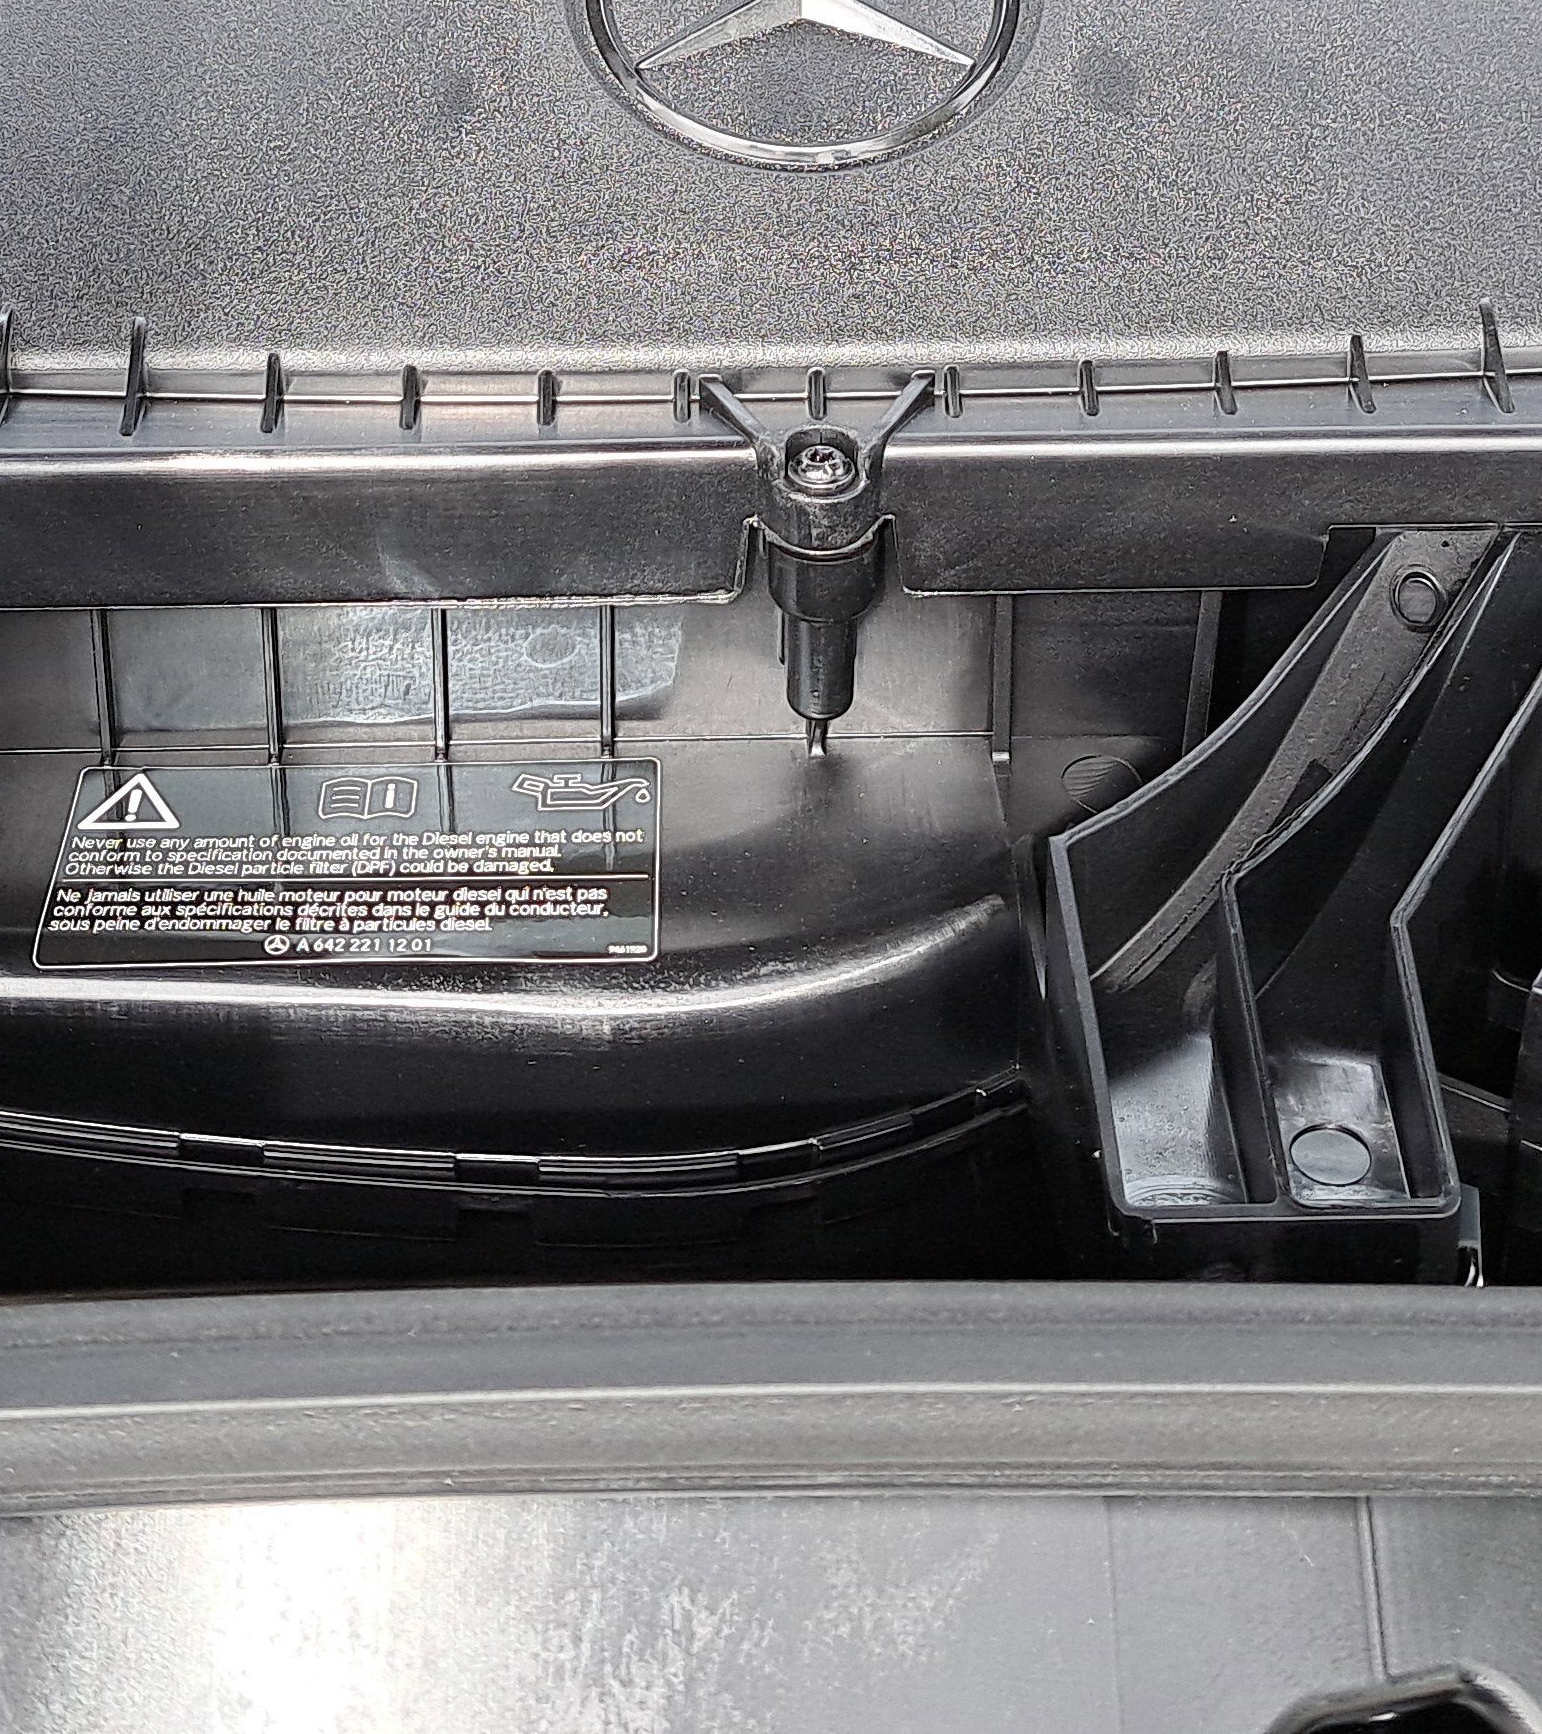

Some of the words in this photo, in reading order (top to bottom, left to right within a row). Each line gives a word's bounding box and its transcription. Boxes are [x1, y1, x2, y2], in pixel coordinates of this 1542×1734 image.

[72, 836, 122, 849] Never
[126, 837, 156, 849] use
[160, 837, 190, 851] any
[193, 835, 255, 849] amount
[260, 834, 279, 848] of
[282, 835, 336, 850] engine
[340, 832, 359, 846] oil
[363, 831, 388, 846] for
[393, 831, 419, 846] the
[422, 830, 472, 846] Diesel
[476, 831, 529, 847] engine
[534, 830, 566, 844] that
[571, 829, 612, 843] does
[615, 829, 644, 843] not
[68, 849, 143, 863] conform
[145, 849, 162, 862] to
[167, 848, 273, 865] specification
[276, 847, 380, 862] documented
[384, 846, 398, 859] in
[403, 846, 428, 859] the
[433, 845, 497, 859] owner's
[501, 844, 562, 858] manual.
[65, 862, 152, 877] Otherwise
[158, 862, 184, 876] the
[188, 862, 238, 876] Diesel
[241, 861, 304, 878] particle
[309, 860, 349, 875] filter
[351, 859, 396, 877] (DPF)
[400, 859, 444, 874] could
[447, 859, 469, 874] be
[57, 888, 80, 903] Ne
[84, 887, 141, 905] jamais
[145, 888, 200, 903] utiliser
[203, 889, 233, 902] une
[238, 887, 276, 902] huile
[278, 888, 341, 903] moteur
[344, 888, 383, 905] pour
[387, 887, 448, 903] moteur
[452, 886, 502, 902] diesel
[505, 885, 531, 905] qui
[533, 885, 574, 902] n'est
[576, 886, 608, 903] pas
[53, 903, 139, 918] conforme
[142, 904, 172, 917] aux
[176, 901, 293, 920] spécifications
[297, 902, 368, 918] décrites
[371, 902, 414, 917] dans
[414, 901, 433, 917] le
[435, 901, 481, 920] guide
[484, 901, 506, 917] du
[509, 900, 610, 919] conducteur,
[48, 917, 90, 931] sous
[93, 916, 140, 934] peine
[144, 916, 271, 934] d'endommager
[275, 916, 290, 931] le
[295, 916, 336, 931] filtre
[339, 916, 350, 931] à
[353, 915, 436, 933] particules
[296, 937, 309, 952] A
[313, 937, 346, 953] 642
[349, 937, 380, 952] 221
[388, 937, 408, 953] 12
[411, 937, 432, 952] 01
